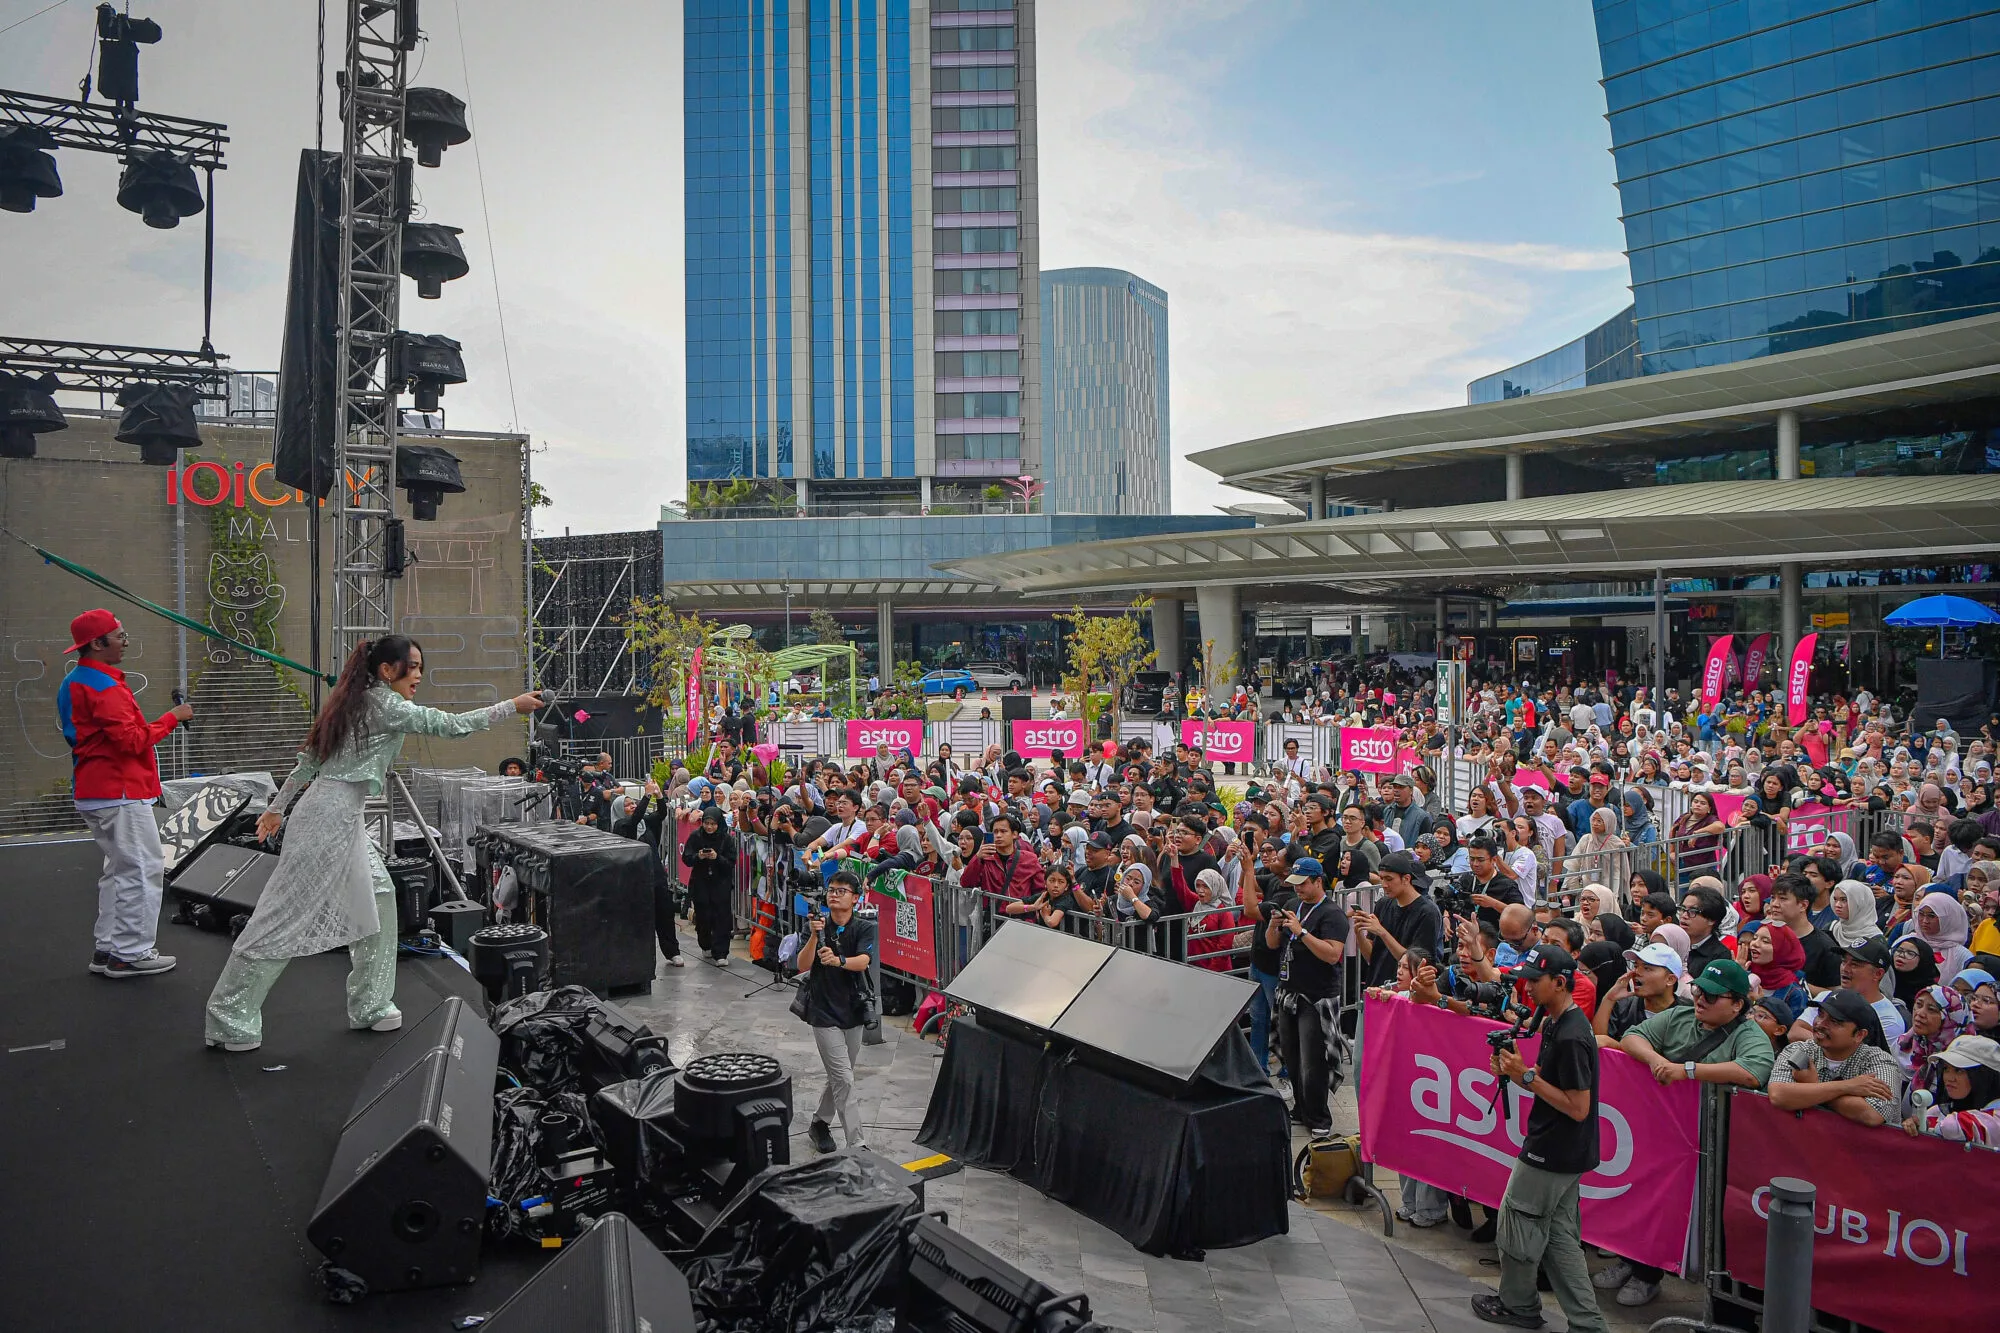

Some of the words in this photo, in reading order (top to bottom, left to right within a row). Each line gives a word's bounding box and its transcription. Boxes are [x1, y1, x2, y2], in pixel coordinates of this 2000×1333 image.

[229, 516, 316, 542] MALL
[1706, 657, 1720, 697] astro
[1747, 650, 1760, 682] astro
[1792, 660, 1805, 705] astro
[859, 727, 910, 745] astro
[1024, 726, 1077, 745] astro
[1192, 729, 1242, 748] astro
[1350, 737, 1393, 757] astro
[1410, 1053, 1634, 1177] asto
[1751, 1186, 1869, 1244] CUB
[1883, 1208, 1968, 1276] IOI
